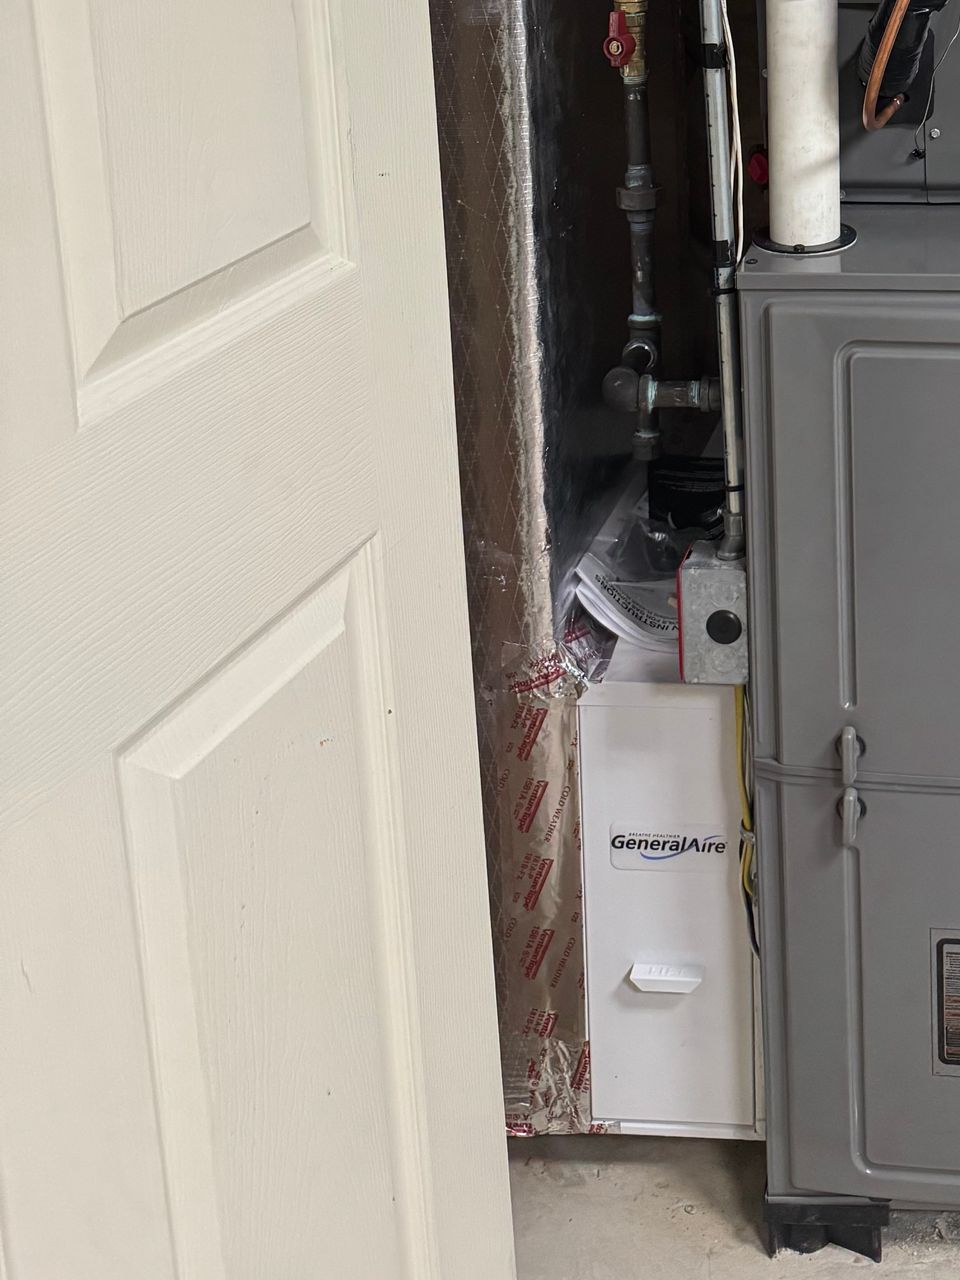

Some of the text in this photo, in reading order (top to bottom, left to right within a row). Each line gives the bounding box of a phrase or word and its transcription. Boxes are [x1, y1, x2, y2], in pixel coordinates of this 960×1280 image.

[543, 785, 571, 843] COLD WEATHER
[611, 834, 726, 854] GeneralAire
